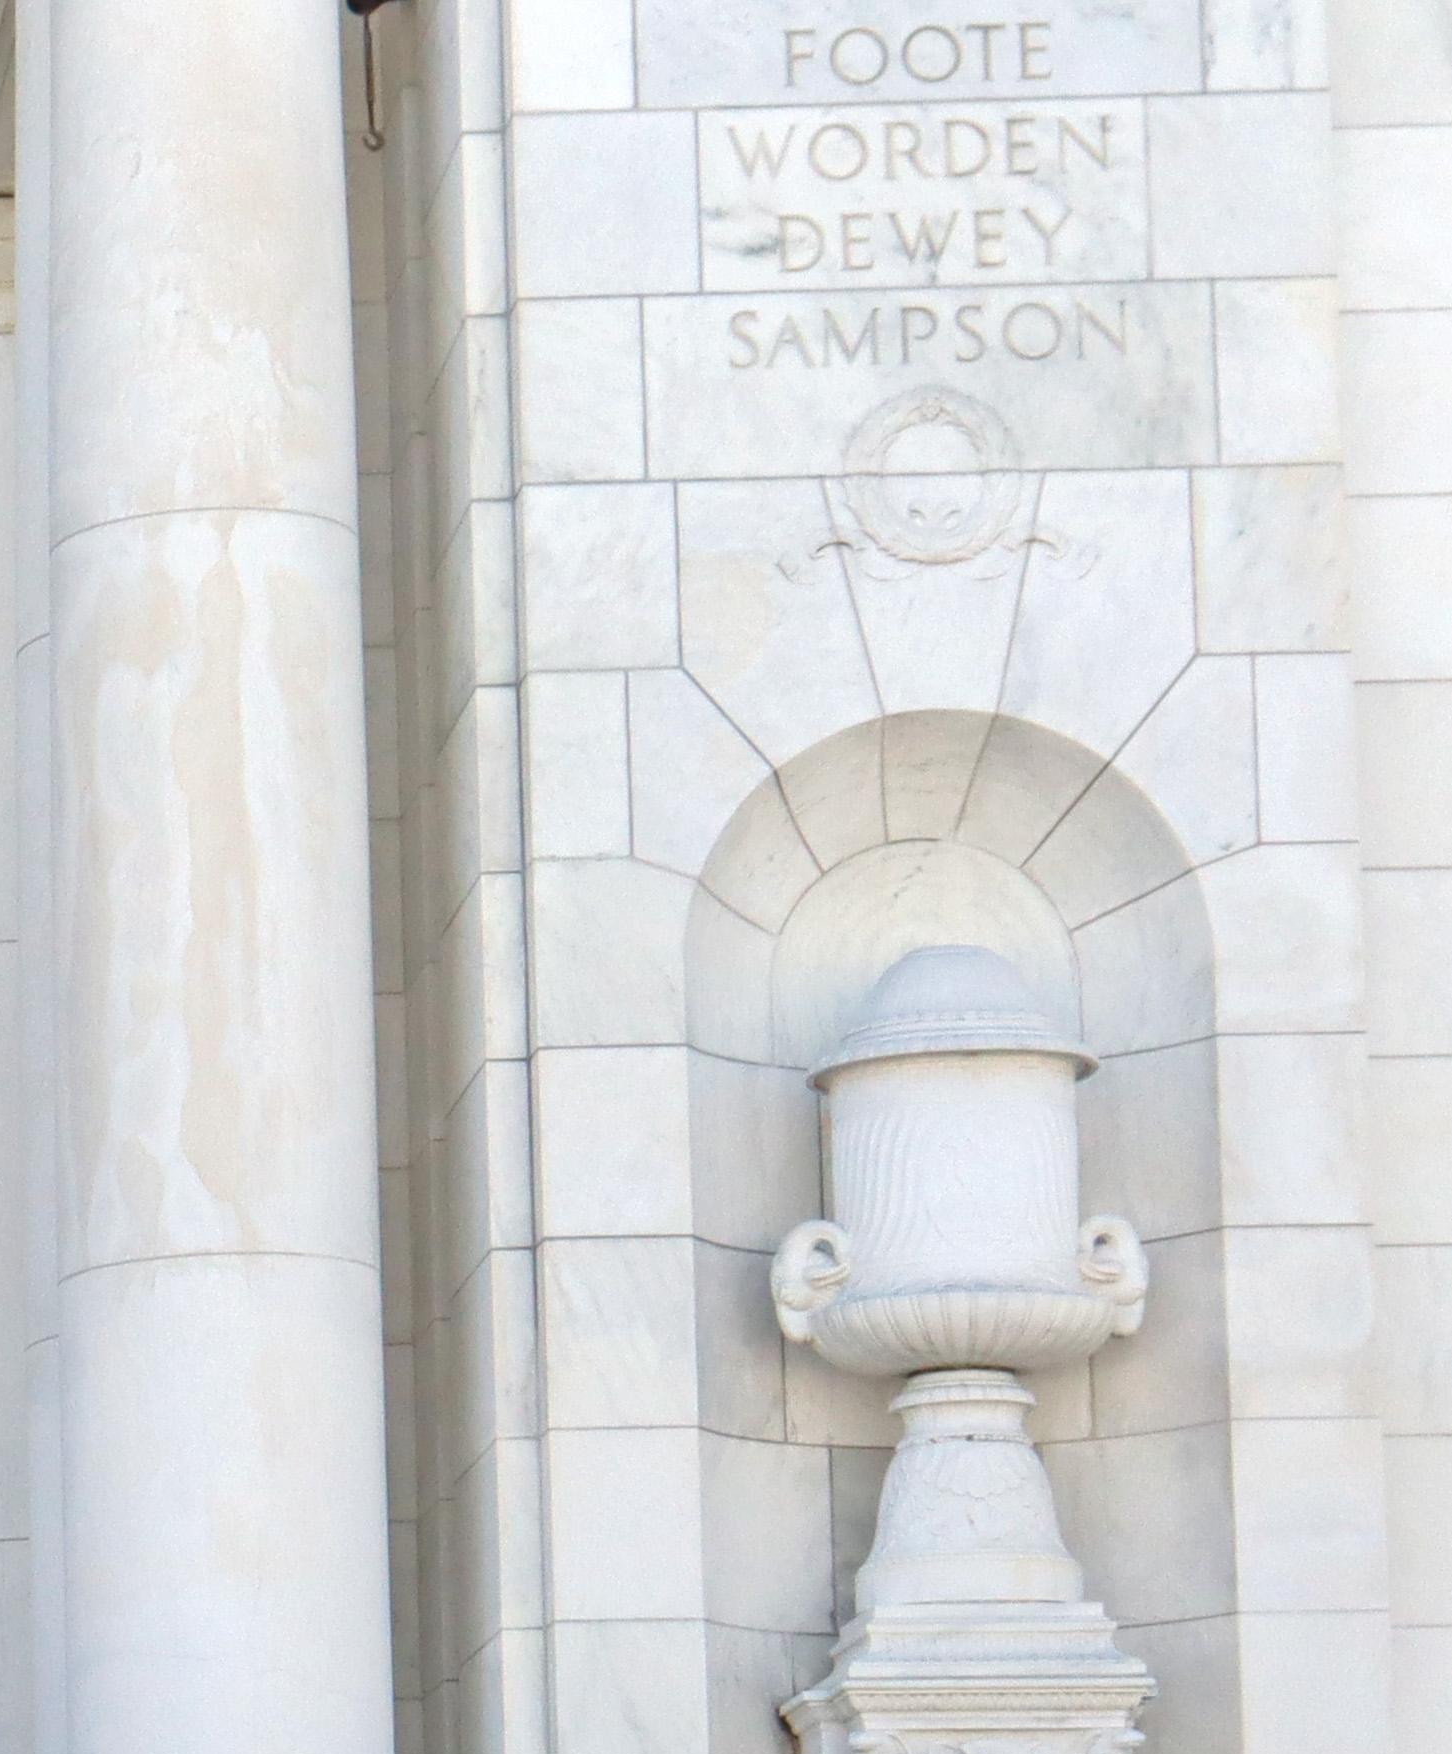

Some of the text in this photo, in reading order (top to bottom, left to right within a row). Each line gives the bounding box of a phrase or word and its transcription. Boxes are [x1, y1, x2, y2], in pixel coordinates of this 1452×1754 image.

[783, 21, 1054, 89] FOOTE
[725, 113, 1115, 183] WORDEN
[777, 206, 1074, 274] DEWEY
[727, 300, 1128, 370] SAMPSON
